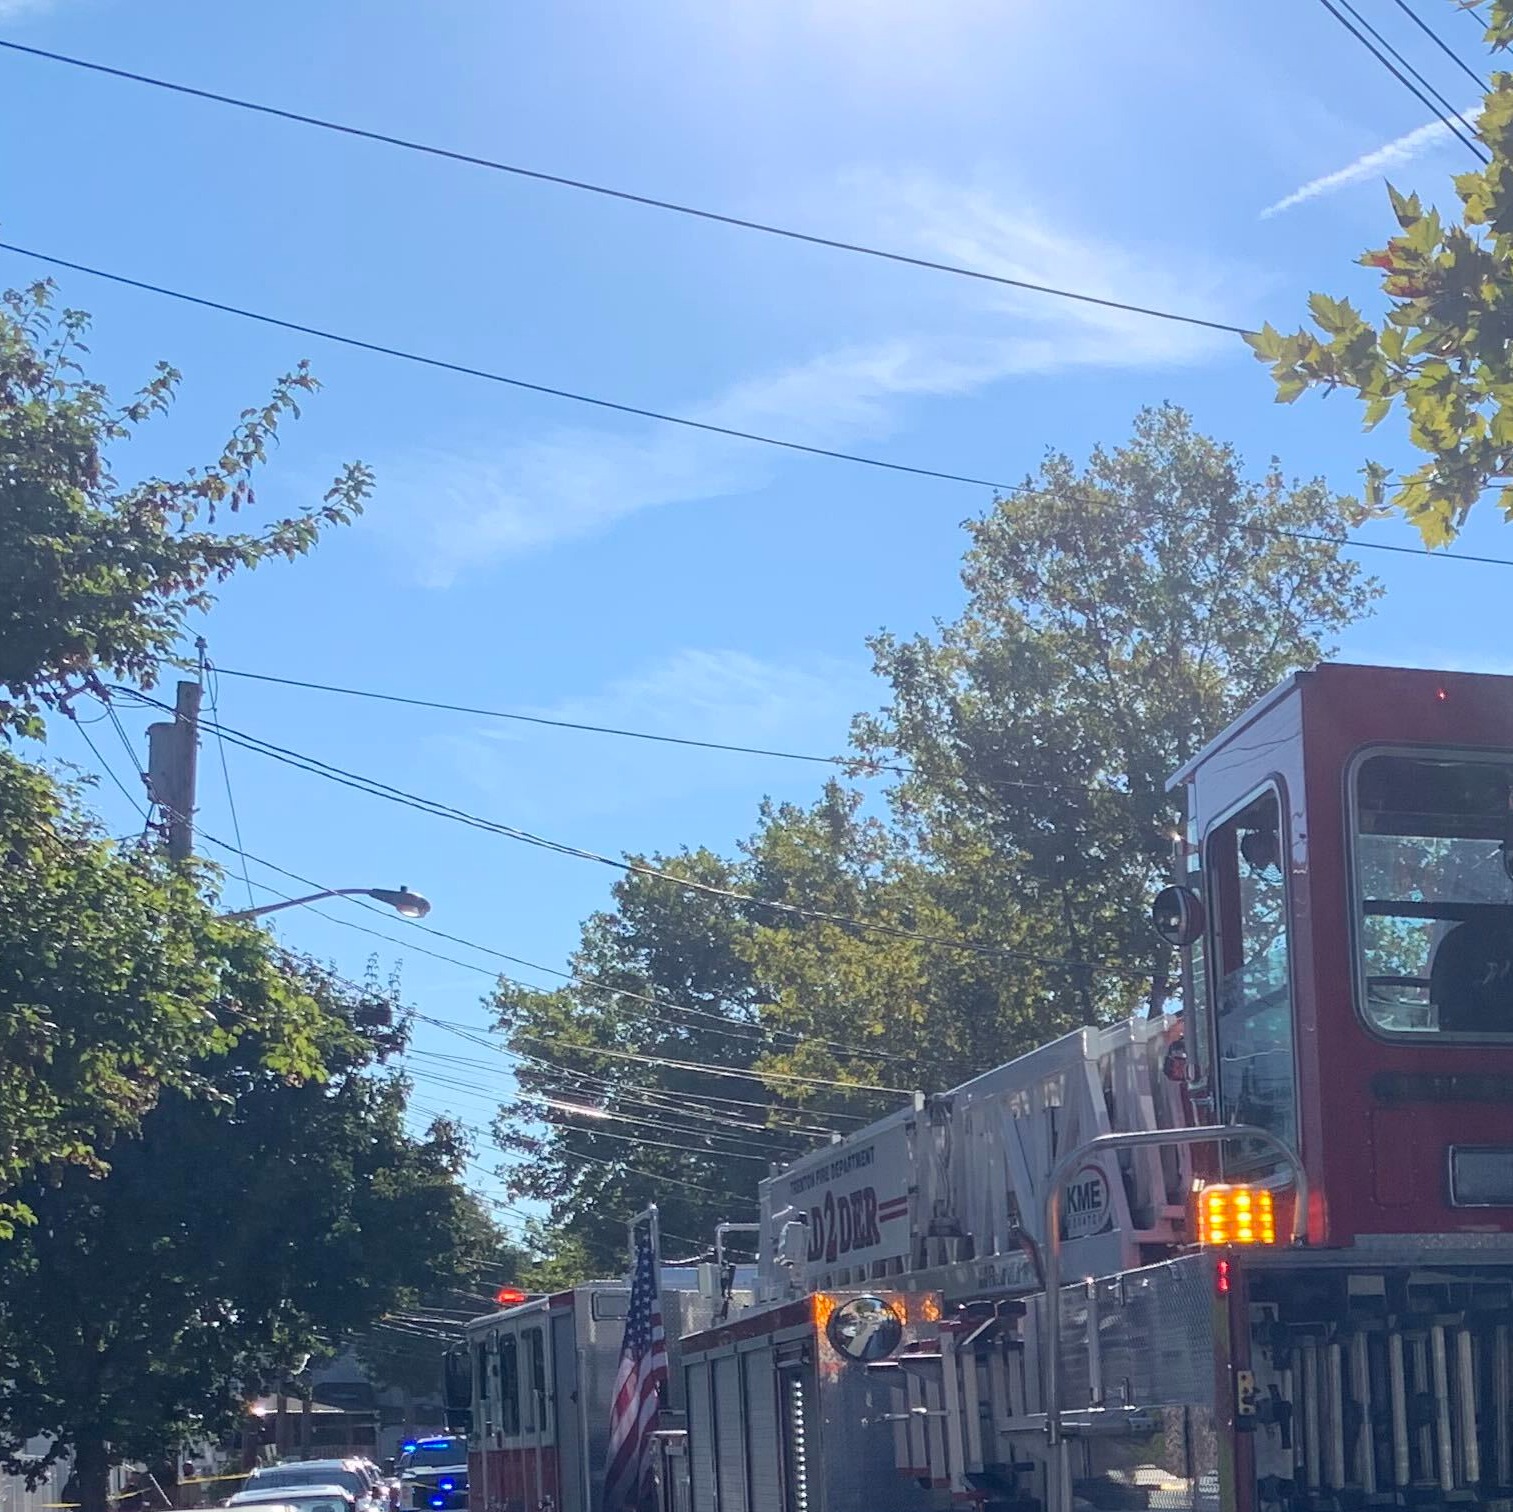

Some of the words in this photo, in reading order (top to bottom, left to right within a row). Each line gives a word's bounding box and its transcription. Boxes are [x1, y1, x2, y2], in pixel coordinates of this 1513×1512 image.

[831, 1146, 874, 1180] DEPARTMENT
[1067, 1180, 1101, 1213] KME
[808, 1187, 881, 1263] D2DER
